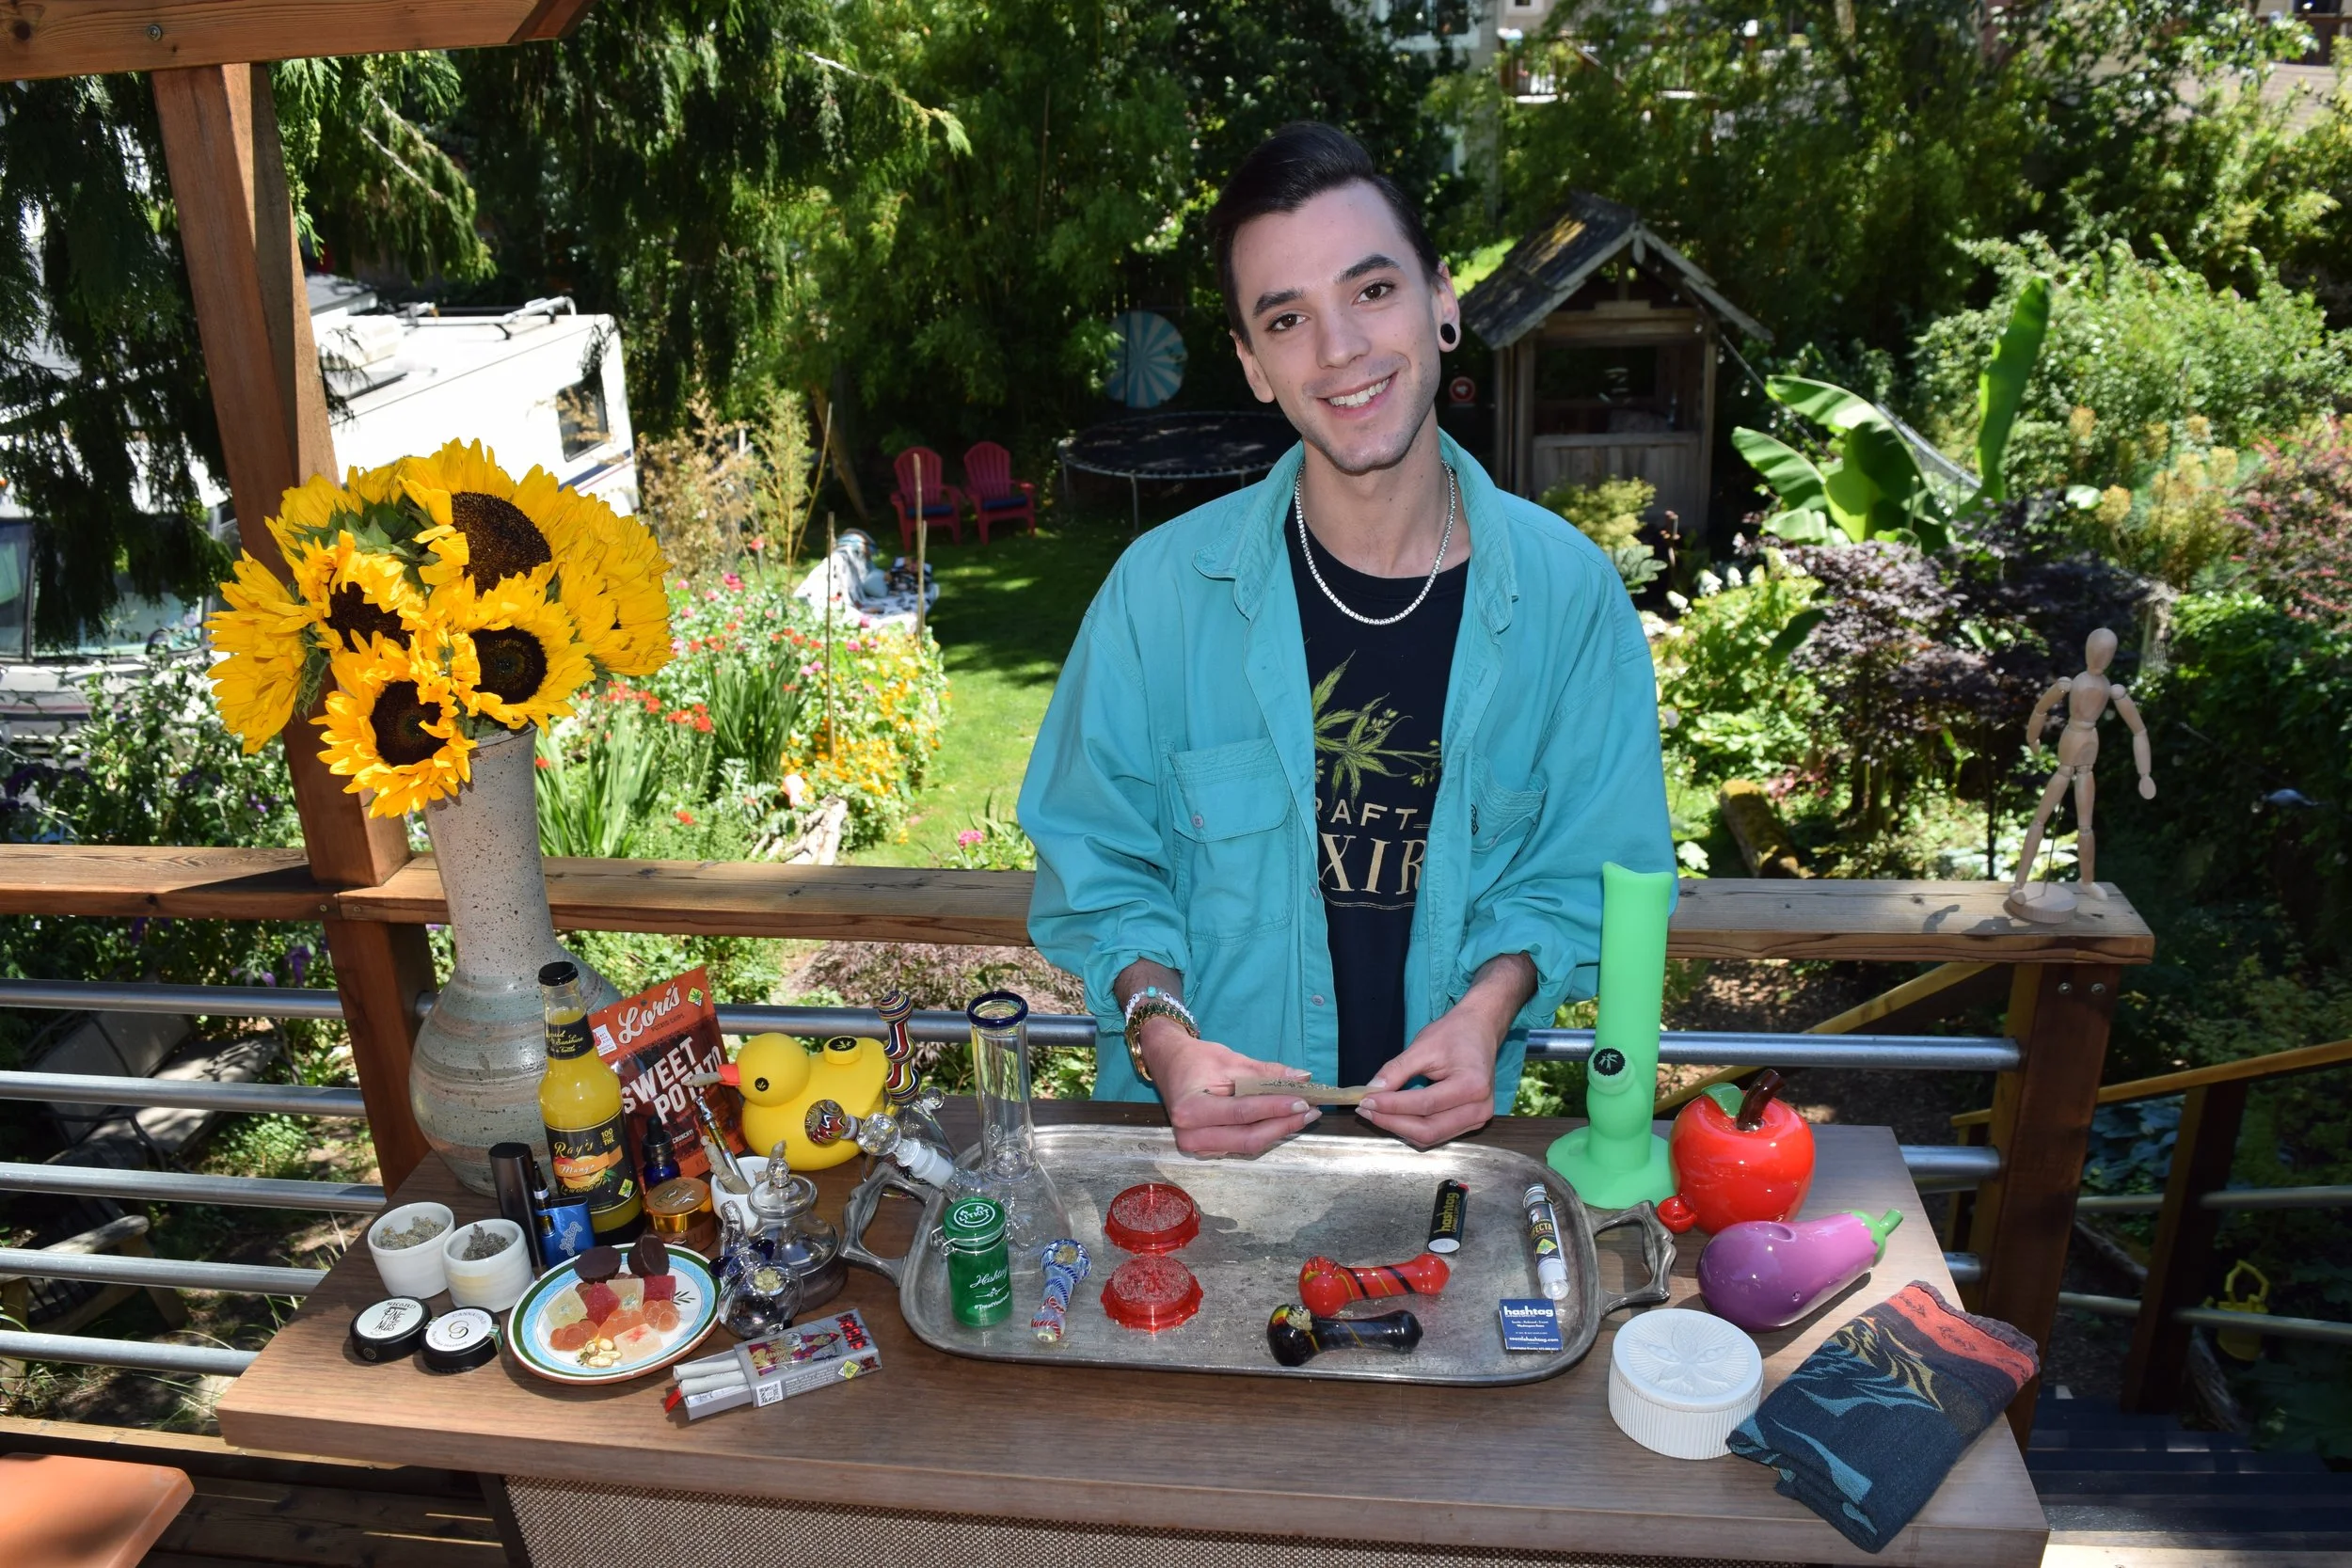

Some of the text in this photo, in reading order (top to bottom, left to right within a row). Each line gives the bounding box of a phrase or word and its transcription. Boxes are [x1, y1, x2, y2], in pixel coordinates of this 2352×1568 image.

[1318, 831, 1426, 895] XIR
[617, 981, 681, 1045] Lori's
[621, 1036, 698, 1114] SWEET
[601, 1128, 613, 1139] 100
[603, 1136, 615, 1146] THC
[554, 1138, 594, 1158] Ray's
[561, 1164, 595, 1175] Mango
[958, 1208, 990, 1222] LITKIT
[1433, 1192, 1460, 1234] hashtag
[969, 1265, 1009, 1289] Hashtag
[1503, 1306, 1554, 1317] hashtag
